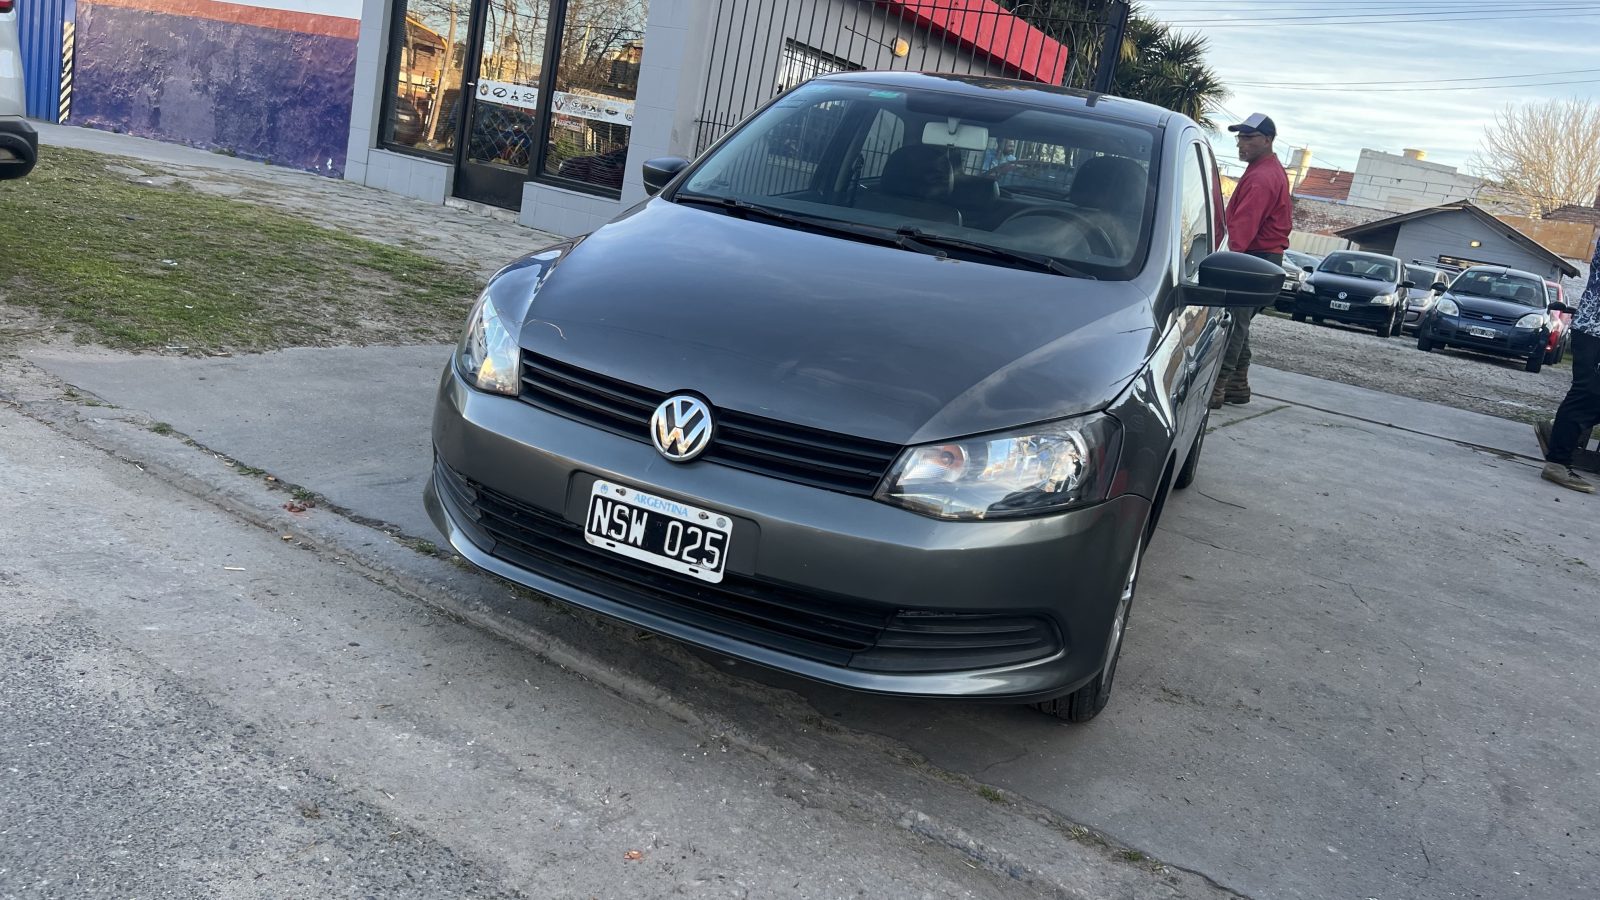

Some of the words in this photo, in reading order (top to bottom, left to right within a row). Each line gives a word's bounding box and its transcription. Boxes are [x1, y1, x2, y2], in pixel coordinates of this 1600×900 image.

[651, 395, 712, 461] VW
[591, 498, 648, 546] NSW
[664, 520, 723, 569] 025
[634, 493, 688, 517] ARGENTINA
